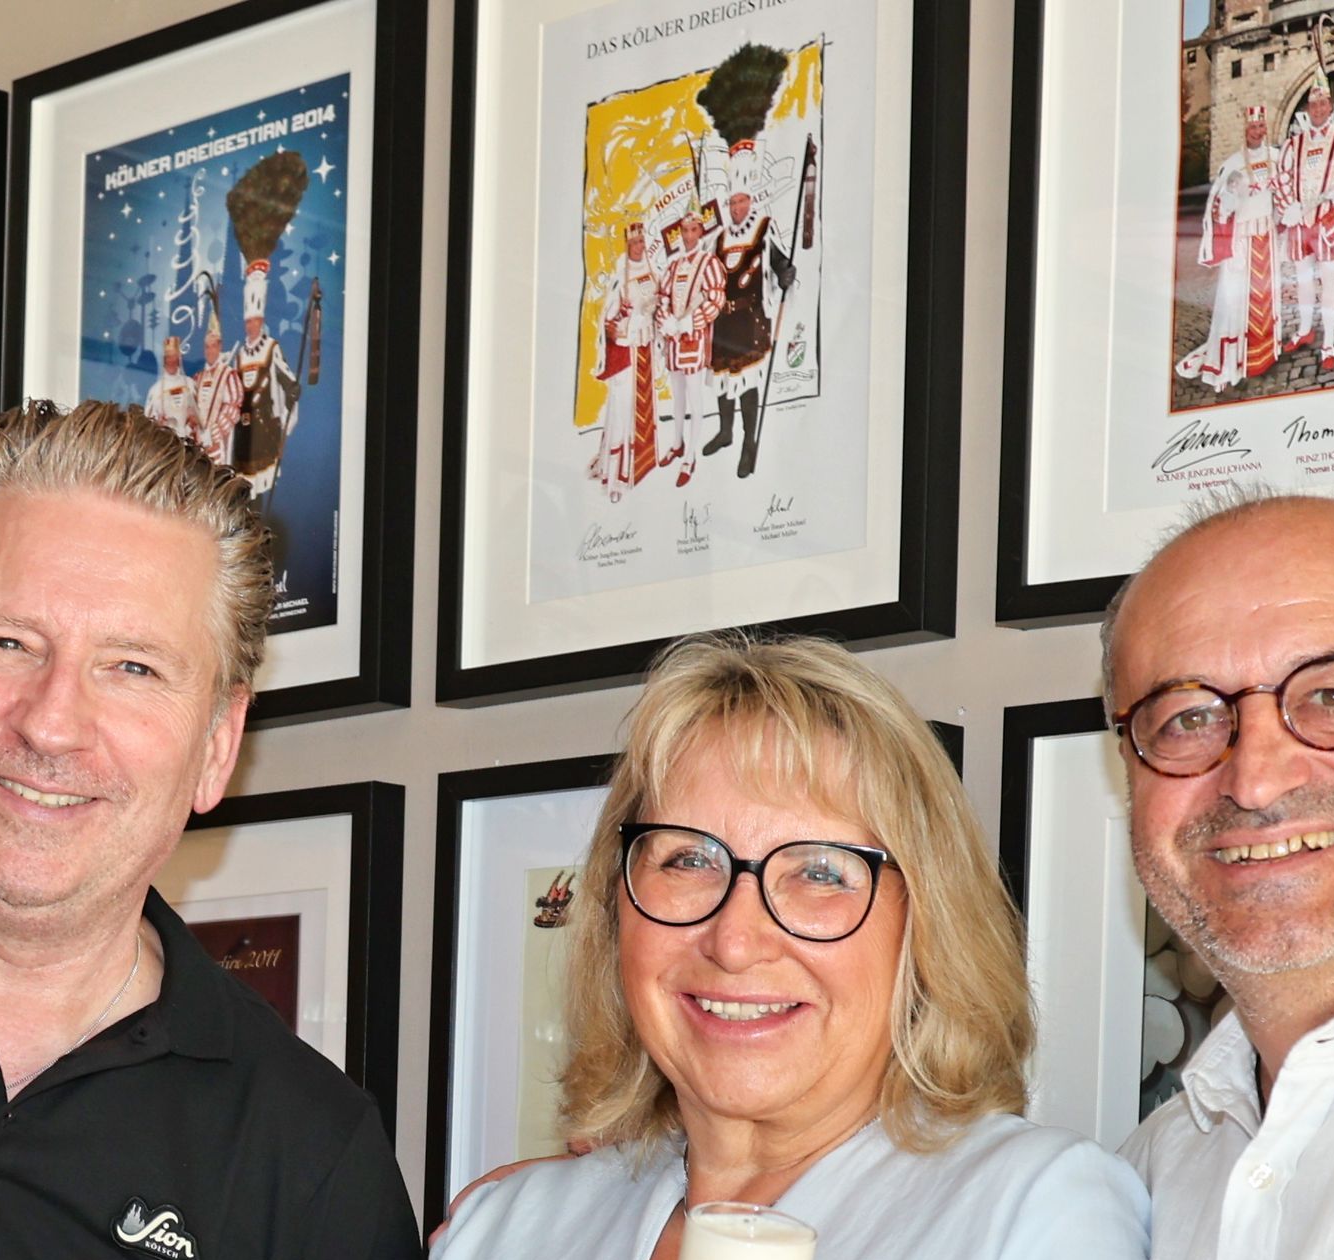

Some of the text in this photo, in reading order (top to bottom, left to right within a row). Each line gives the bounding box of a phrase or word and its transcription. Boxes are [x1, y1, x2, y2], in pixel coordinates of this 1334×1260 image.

[586, 0, 786, 59] DAS KÖLNER DREIGES
[105, 104, 337, 191] KÖLNER DREIGESTIRN 2014
[655, 179, 693, 212] HOLGE
[1295, 454, 1318, 465] PRINZ
[1305, 465, 1331, 475] Thomas
[117, 1211, 194, 1258] Sion
[145, 1240, 179, 1259] KÖLSCH
